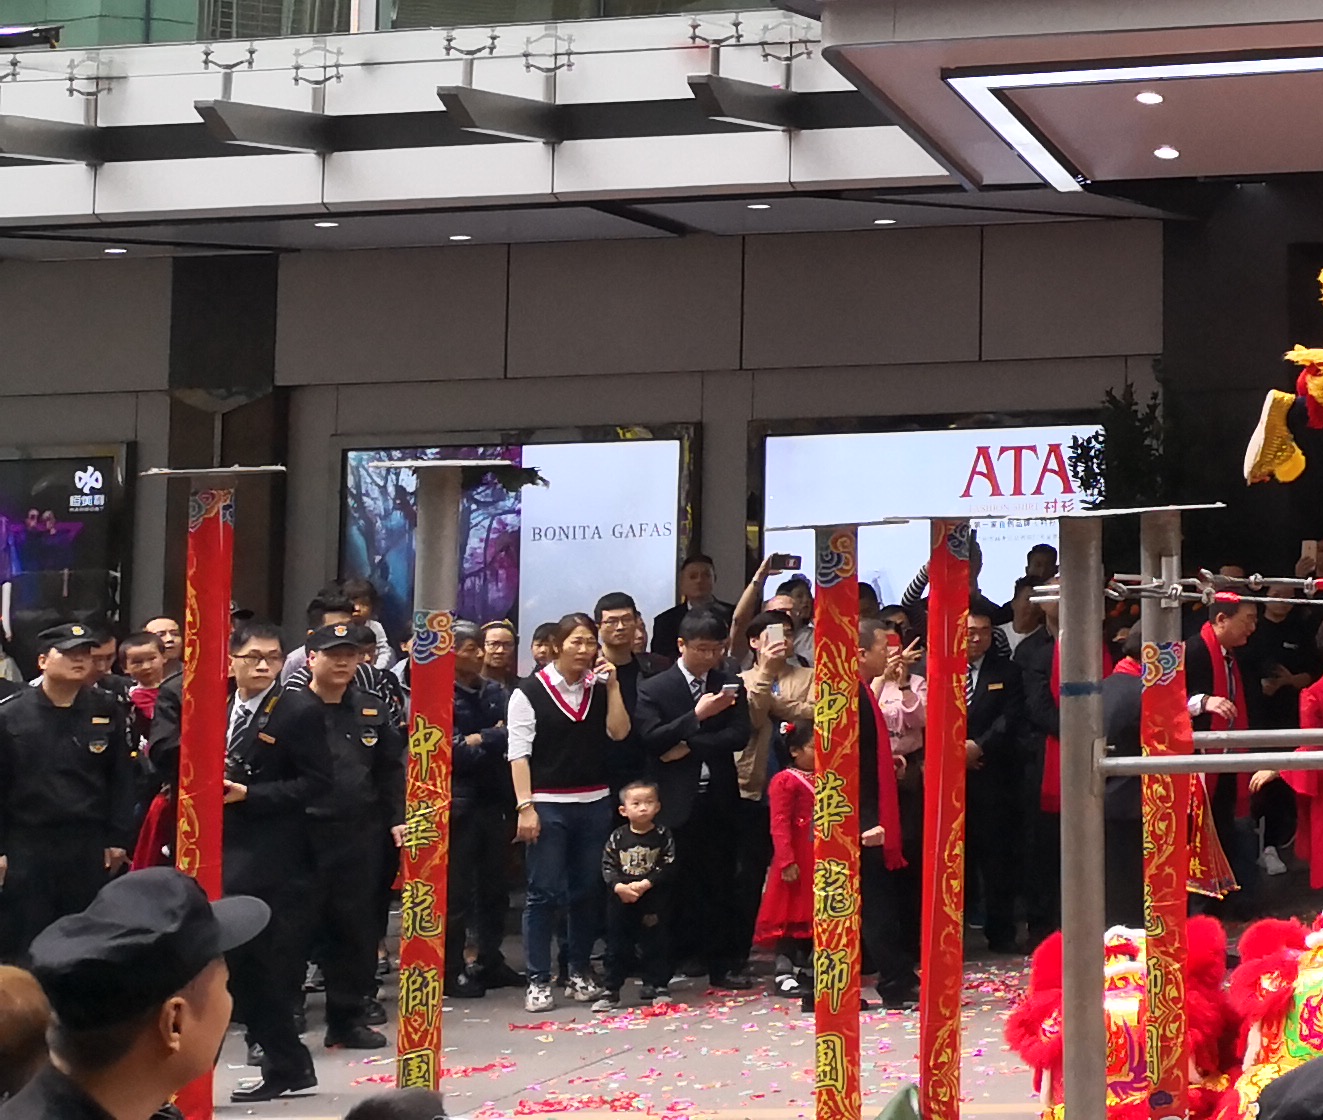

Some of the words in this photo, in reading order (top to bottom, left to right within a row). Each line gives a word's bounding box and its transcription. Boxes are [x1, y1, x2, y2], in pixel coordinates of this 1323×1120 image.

[959, 443, 1077, 498] ATA
[531, 525, 604, 542] BONITA
[611, 521, 673, 539] GAFAS
